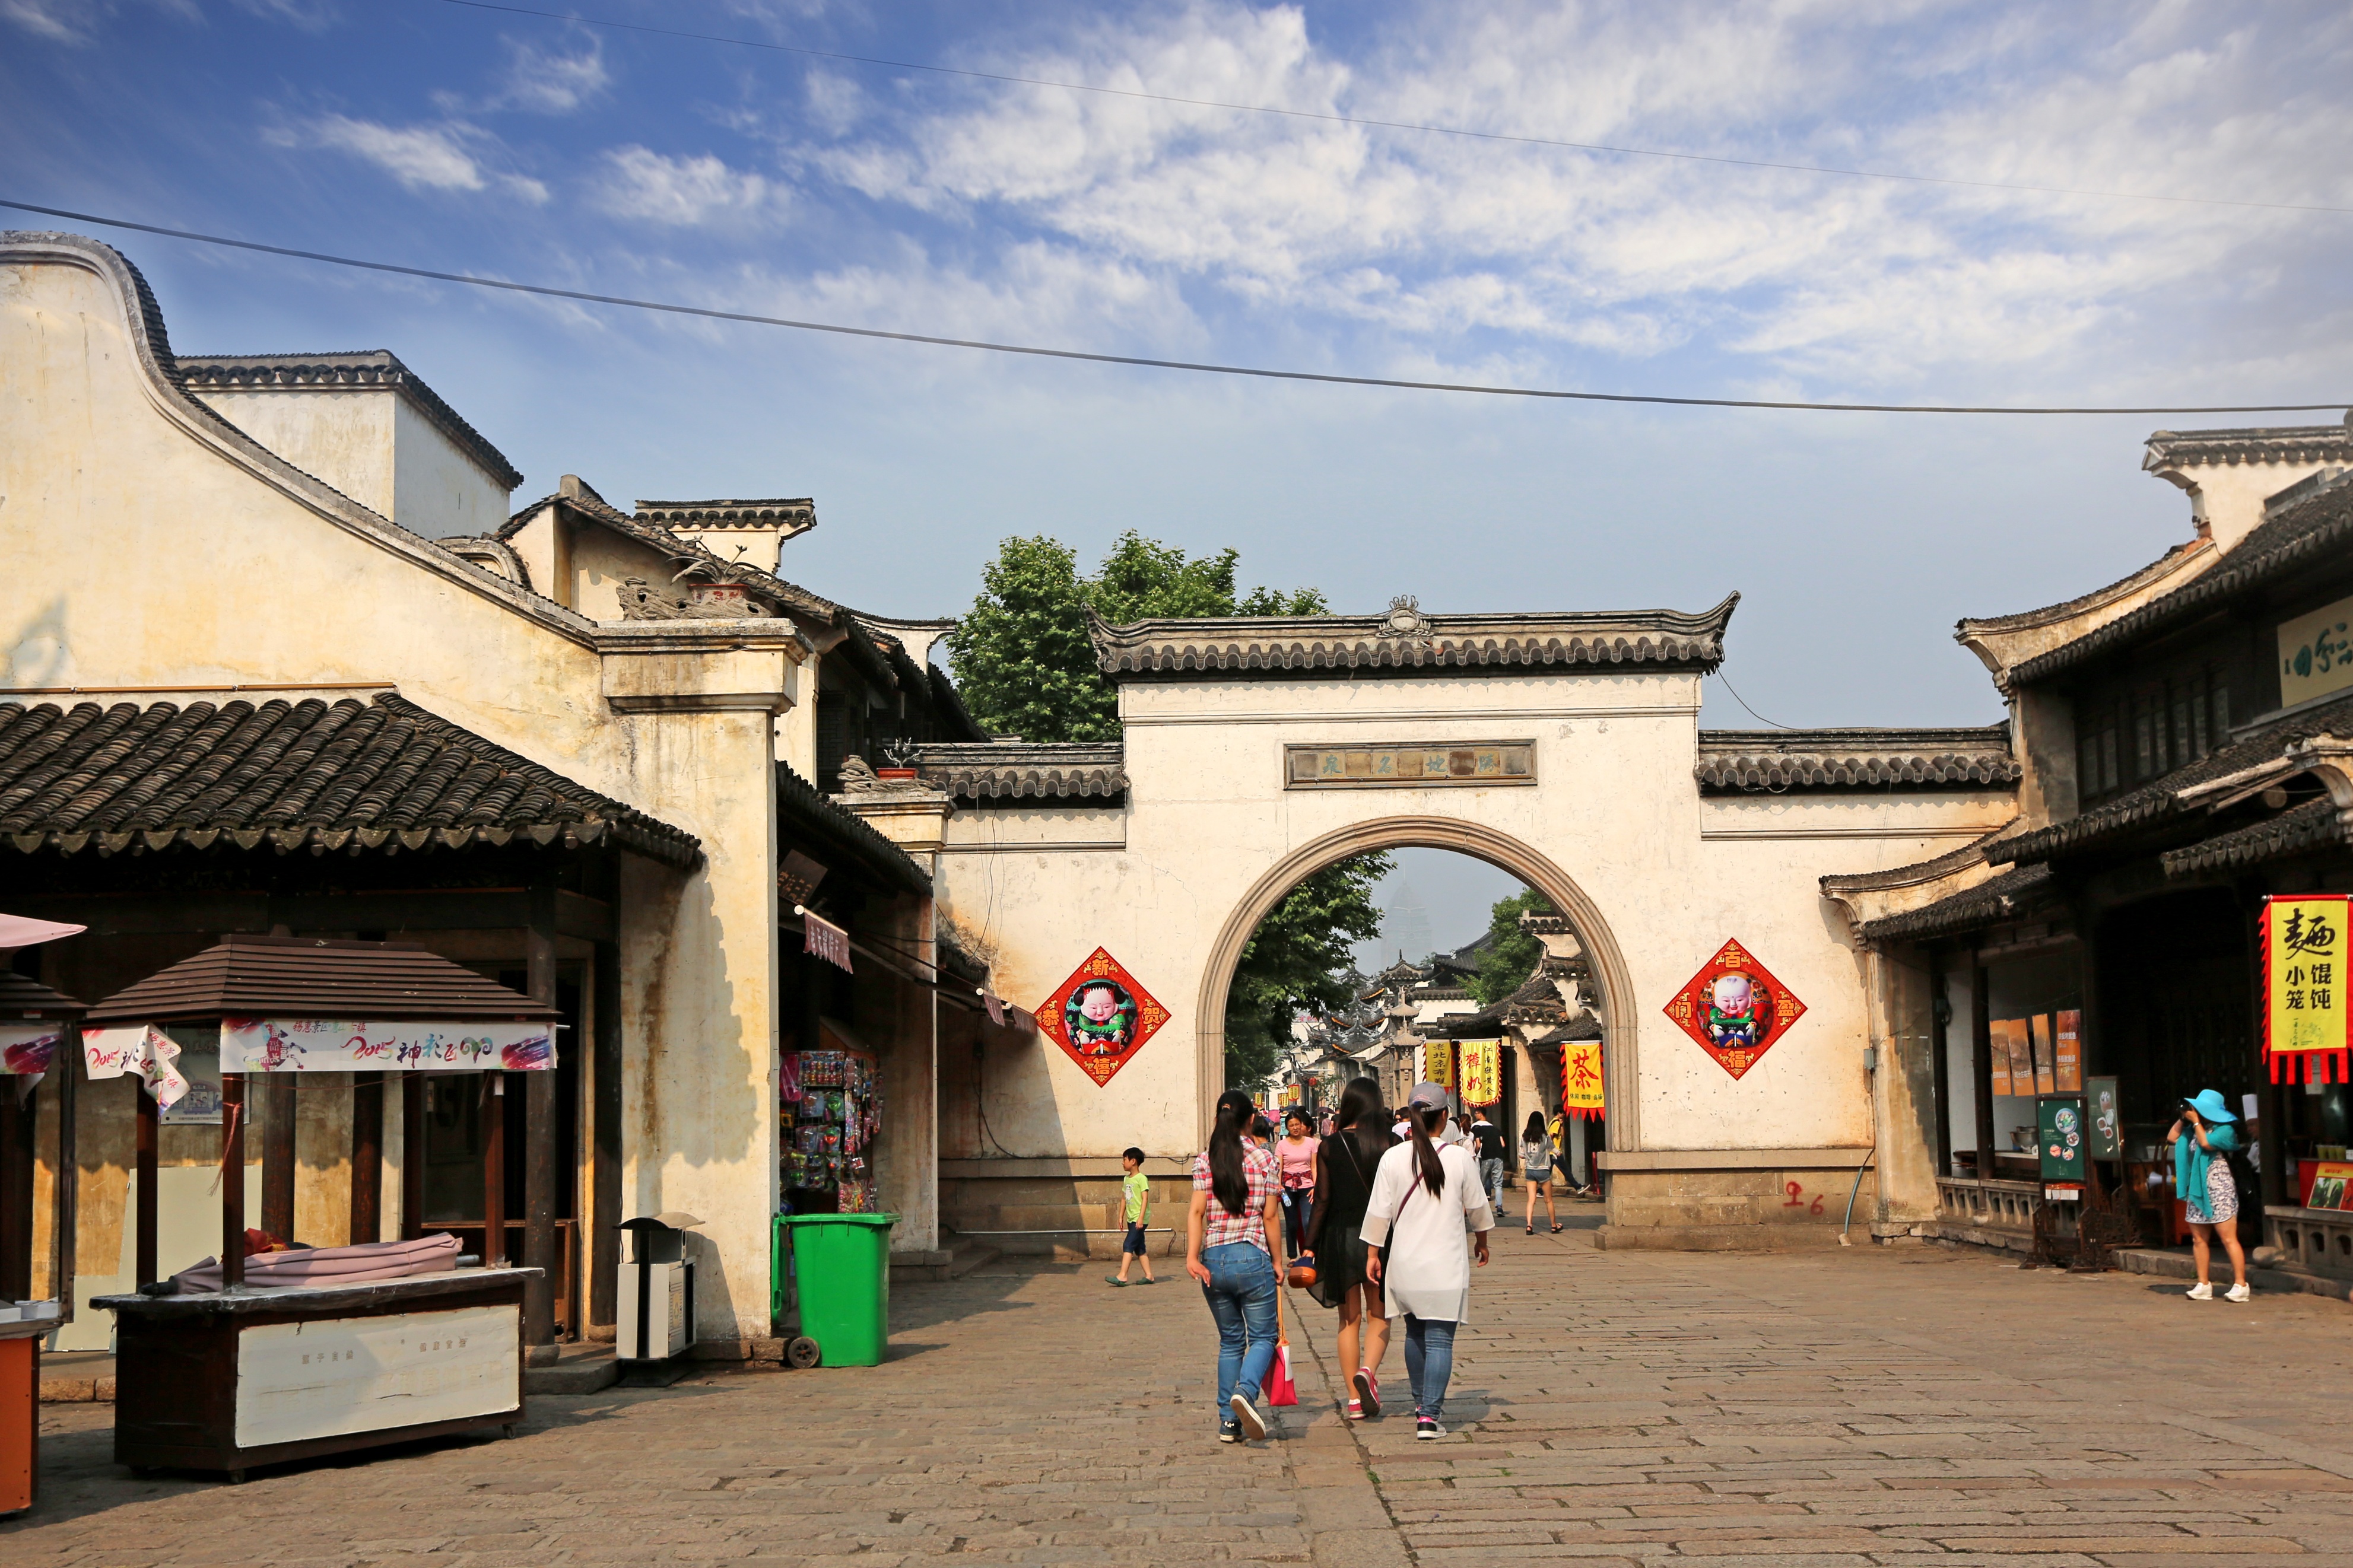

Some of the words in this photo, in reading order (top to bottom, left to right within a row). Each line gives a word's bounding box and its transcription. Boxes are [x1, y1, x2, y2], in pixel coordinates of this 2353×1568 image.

[1091, 959, 1109, 976] 新
[1724, 951, 1741, 968] 百
[2285, 966, 2305, 1010] 小笼
[2310, 963, 2331, 1010] 馄饨
[1143, 1007, 1160, 1025] 贺
[1675, 1001, 1691, 1018] 门
[1777, 999, 1795, 1017] 盈
[1042, 1009, 1059, 1026] 恭
[1093, 1057, 1110, 1074] 禧
[1433, 1043, 1447, 1084] 老北京布鞋
[1728, 1051, 1746, 1068] 福
[1570, 1048, 1599, 1090] 茶
